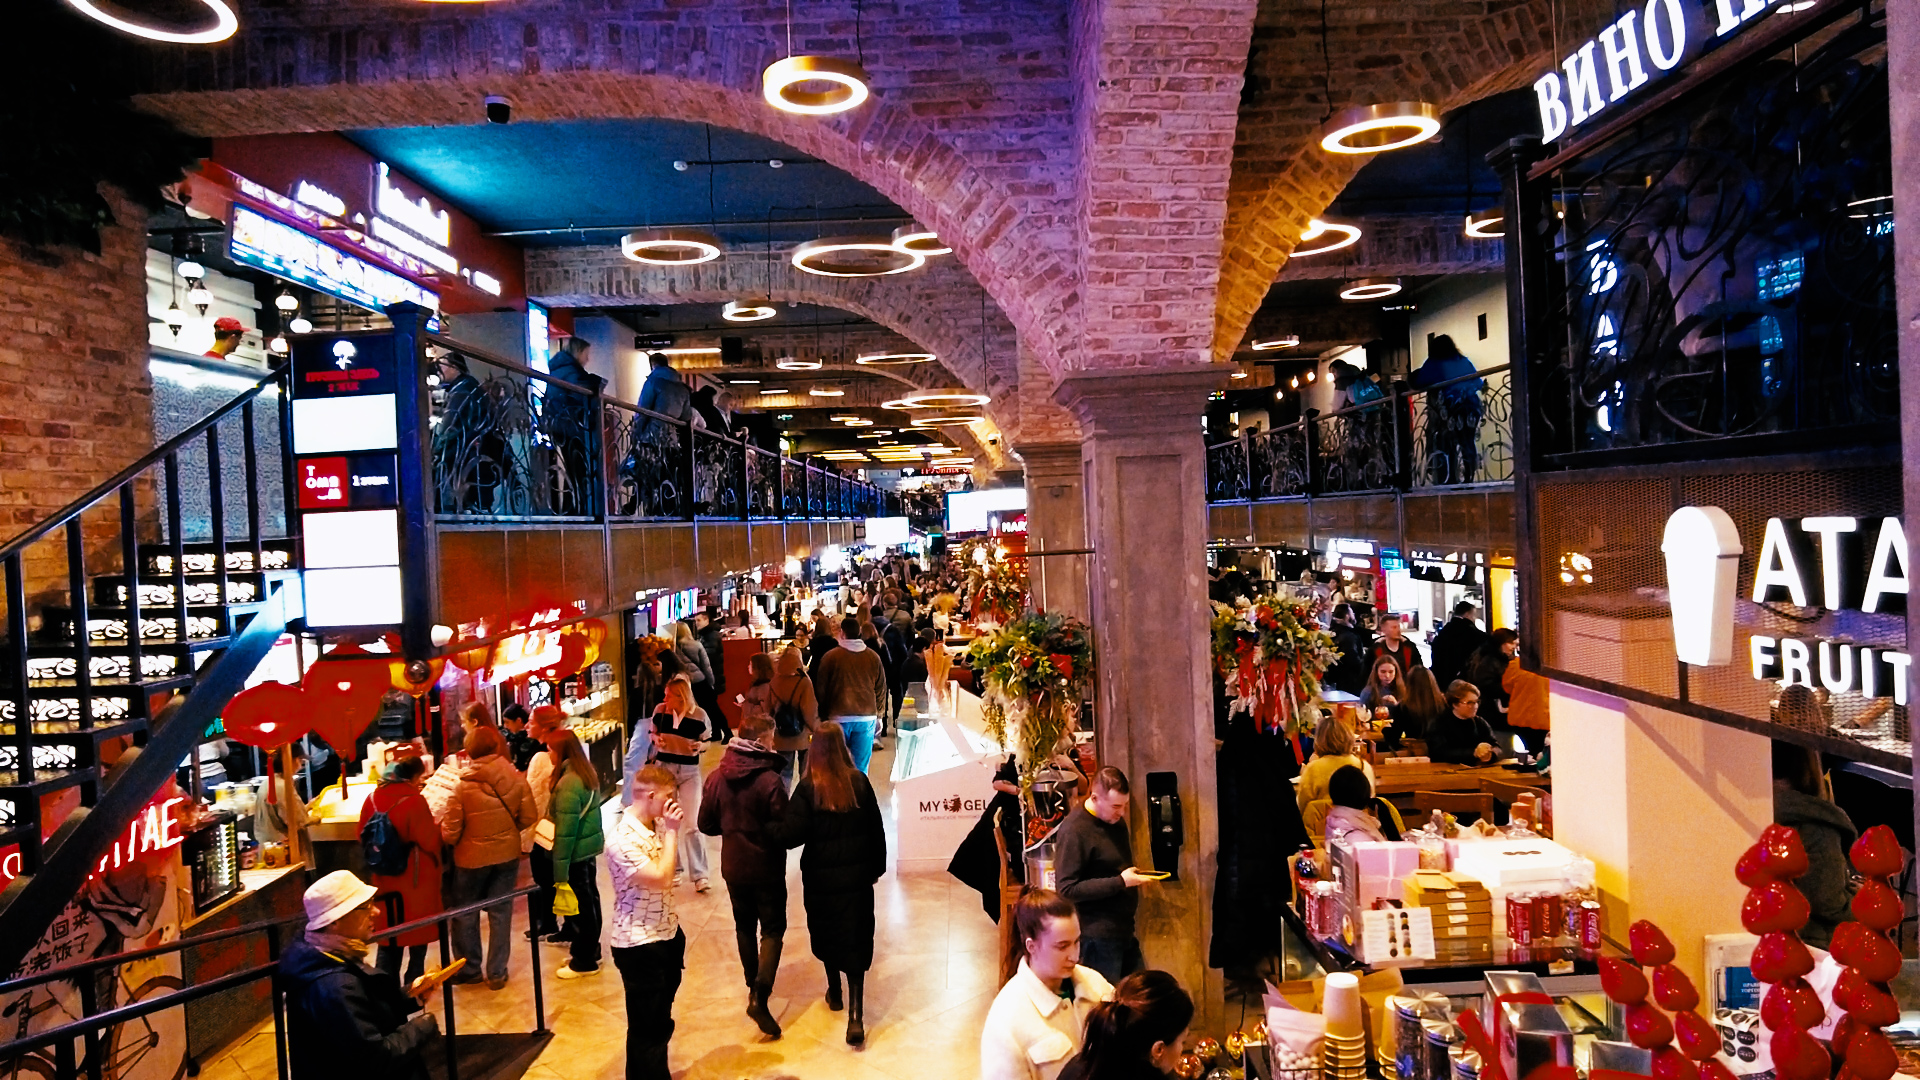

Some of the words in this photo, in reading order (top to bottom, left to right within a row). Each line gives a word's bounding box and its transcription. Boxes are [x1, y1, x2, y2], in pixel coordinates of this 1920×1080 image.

[1533, 0, 1686, 145] ВИНО
[1750, 635, 1912, 706] FRUIT
[919, 801, 941, 812] MY
